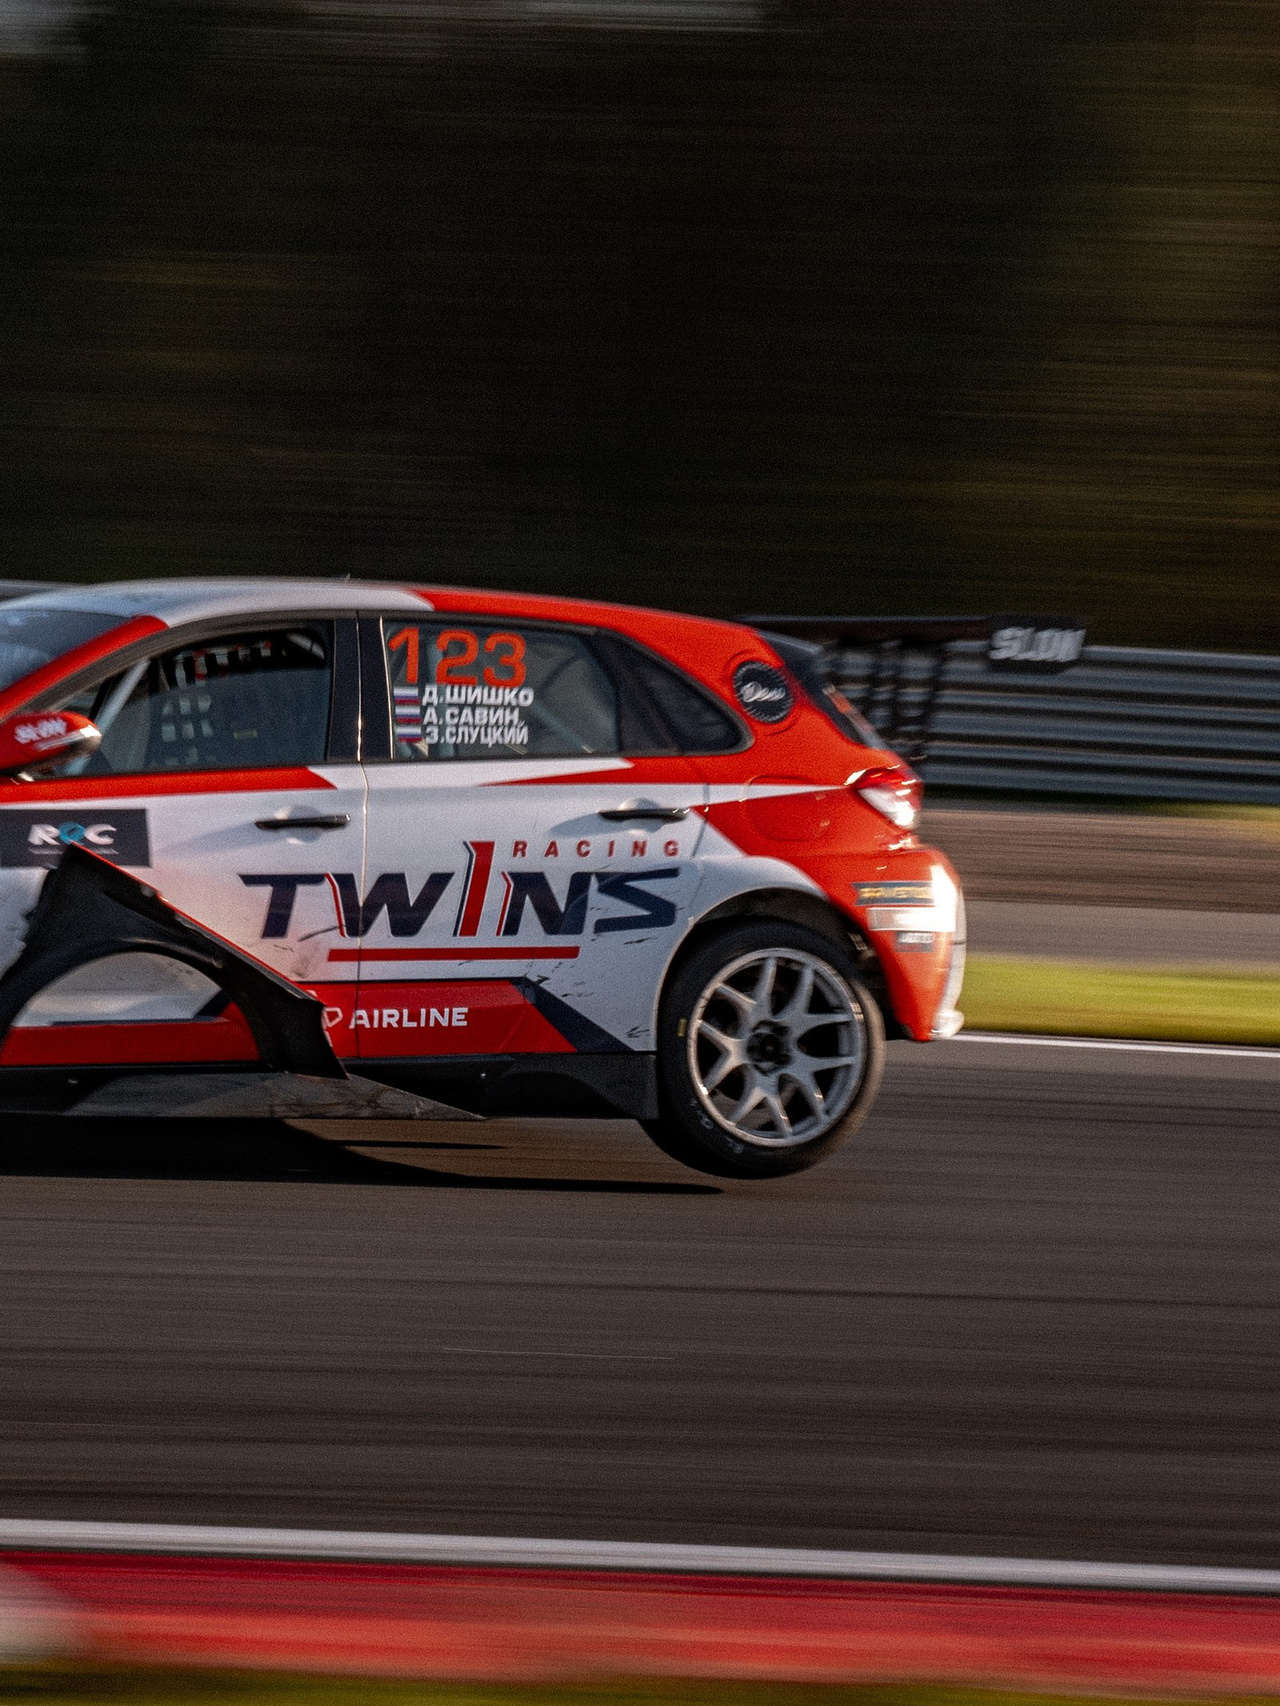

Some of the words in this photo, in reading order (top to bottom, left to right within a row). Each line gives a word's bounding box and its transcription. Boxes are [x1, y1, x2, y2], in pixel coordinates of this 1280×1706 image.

[388, 626, 527, 688] 123
[422, 683, 535, 707] Д.ШИШКО
[423, 706, 520, 725] А.САВИН
[512, 839, 679, 858] RACING
[238, 840, 681, 938] TWINS
[348, 1007, 469, 1030] AIRLINE
